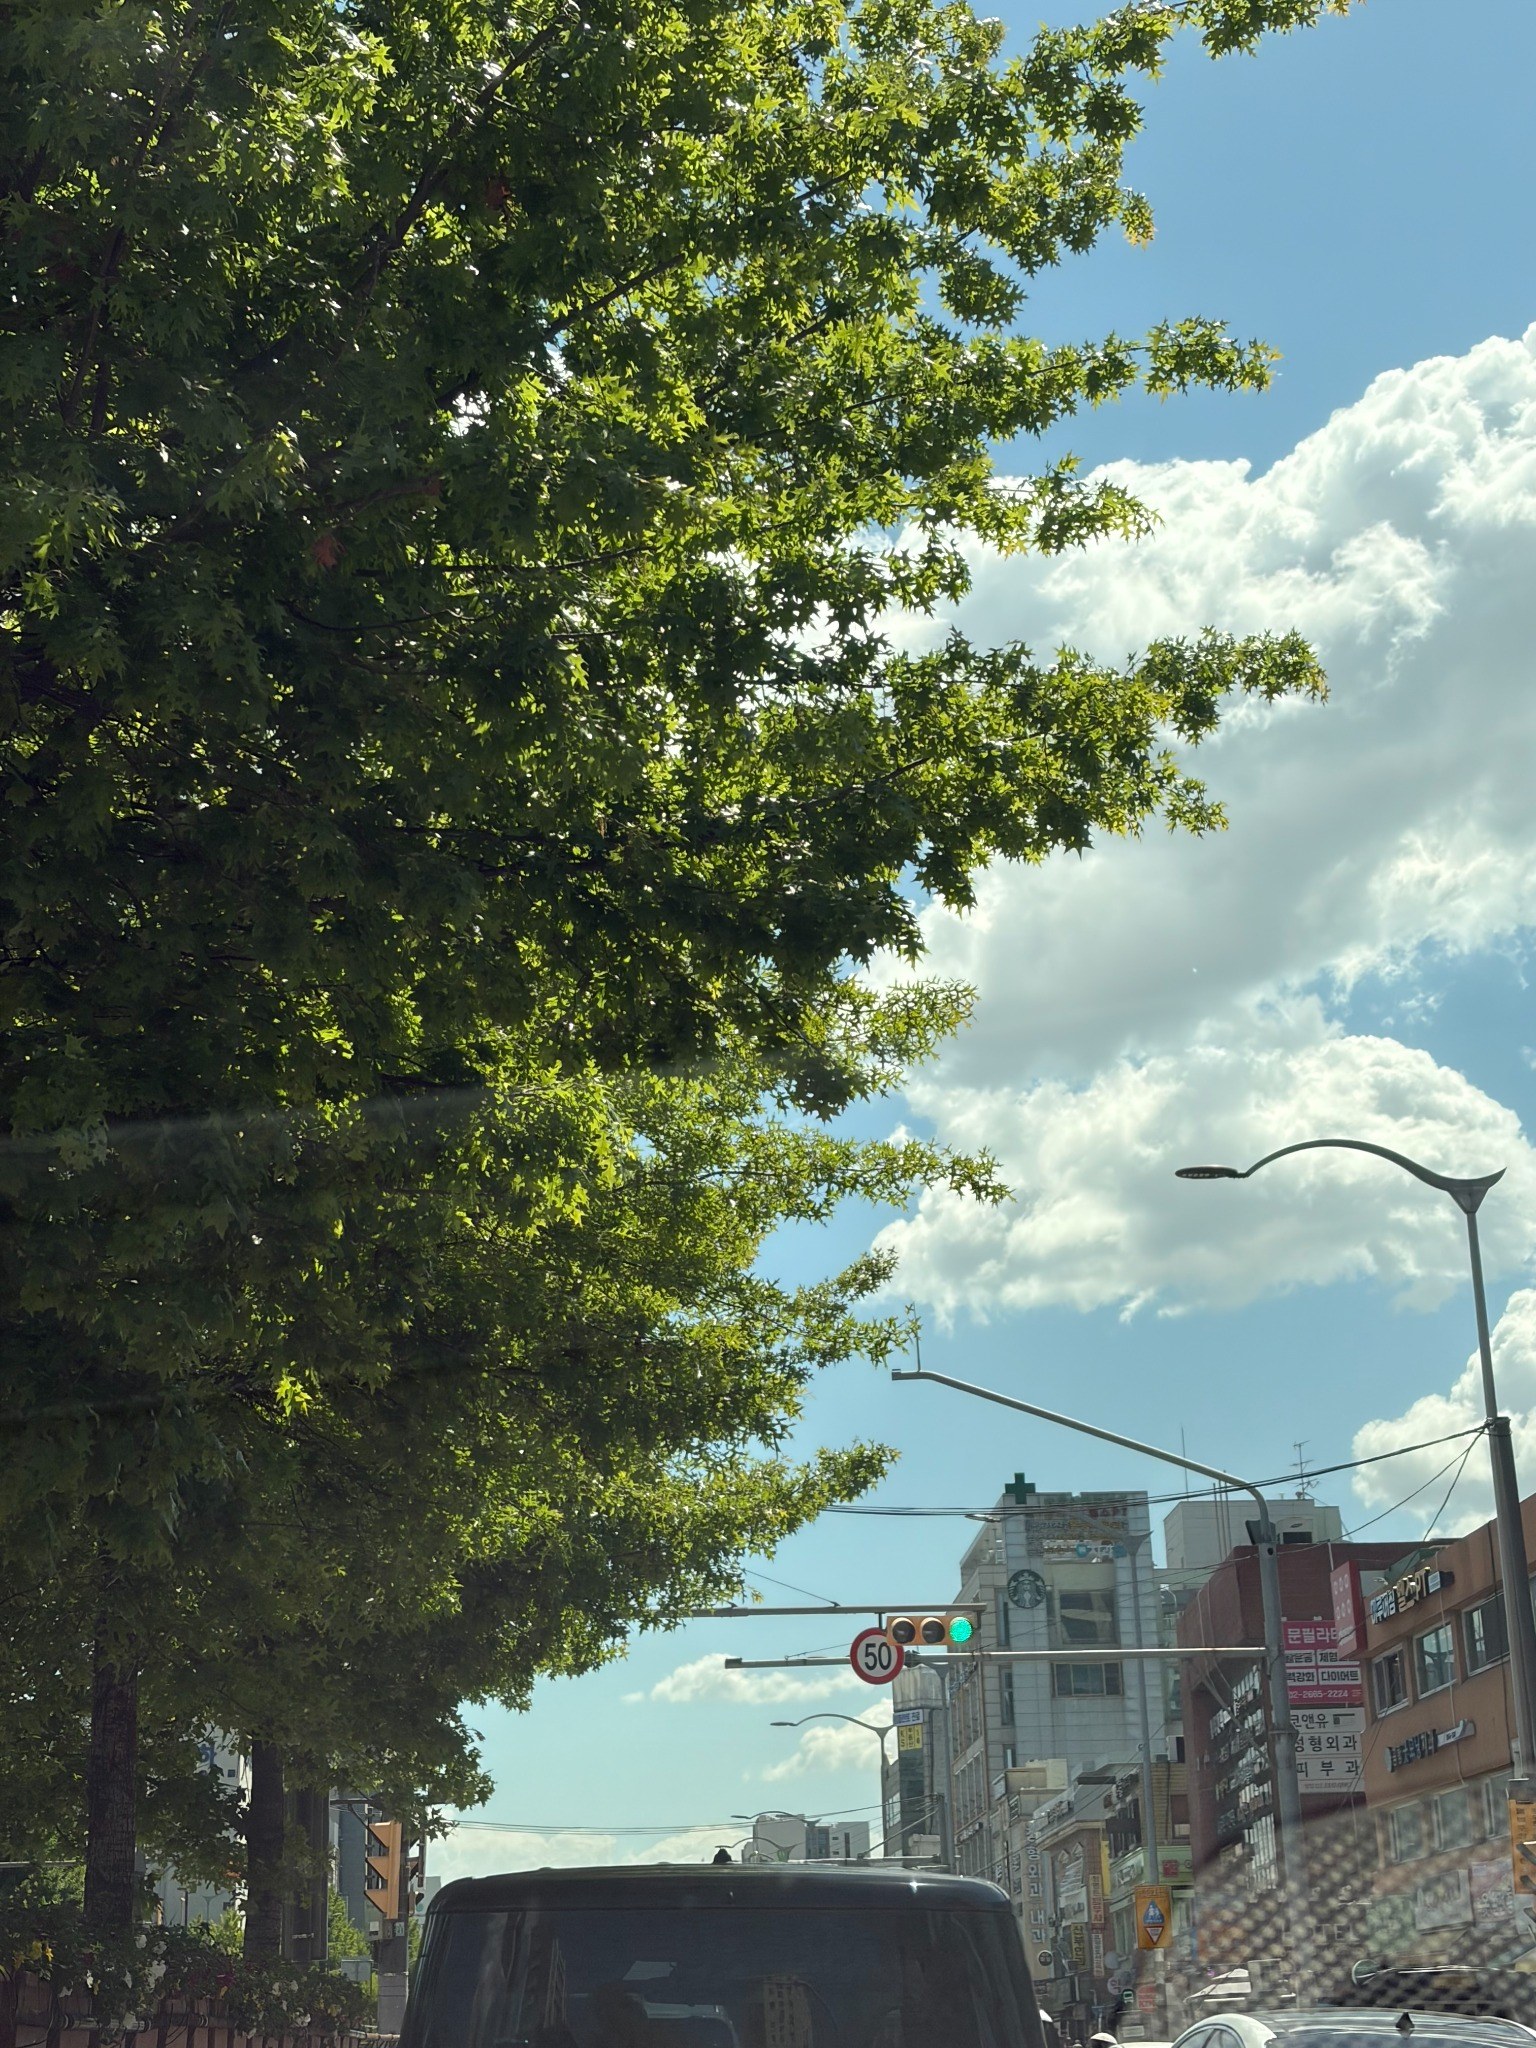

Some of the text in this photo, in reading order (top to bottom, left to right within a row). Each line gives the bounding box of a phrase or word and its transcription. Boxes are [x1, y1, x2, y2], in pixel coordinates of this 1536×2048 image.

[864, 1642, 892, 1671] 50
[1321, 1670, 1360, 1682] 다이어트
[1294, 1734, 1358, 1753] 성형외과
[1296, 1759, 1361, 1778] 피부과
[1030, 1908, 1046, 1944] 내과
